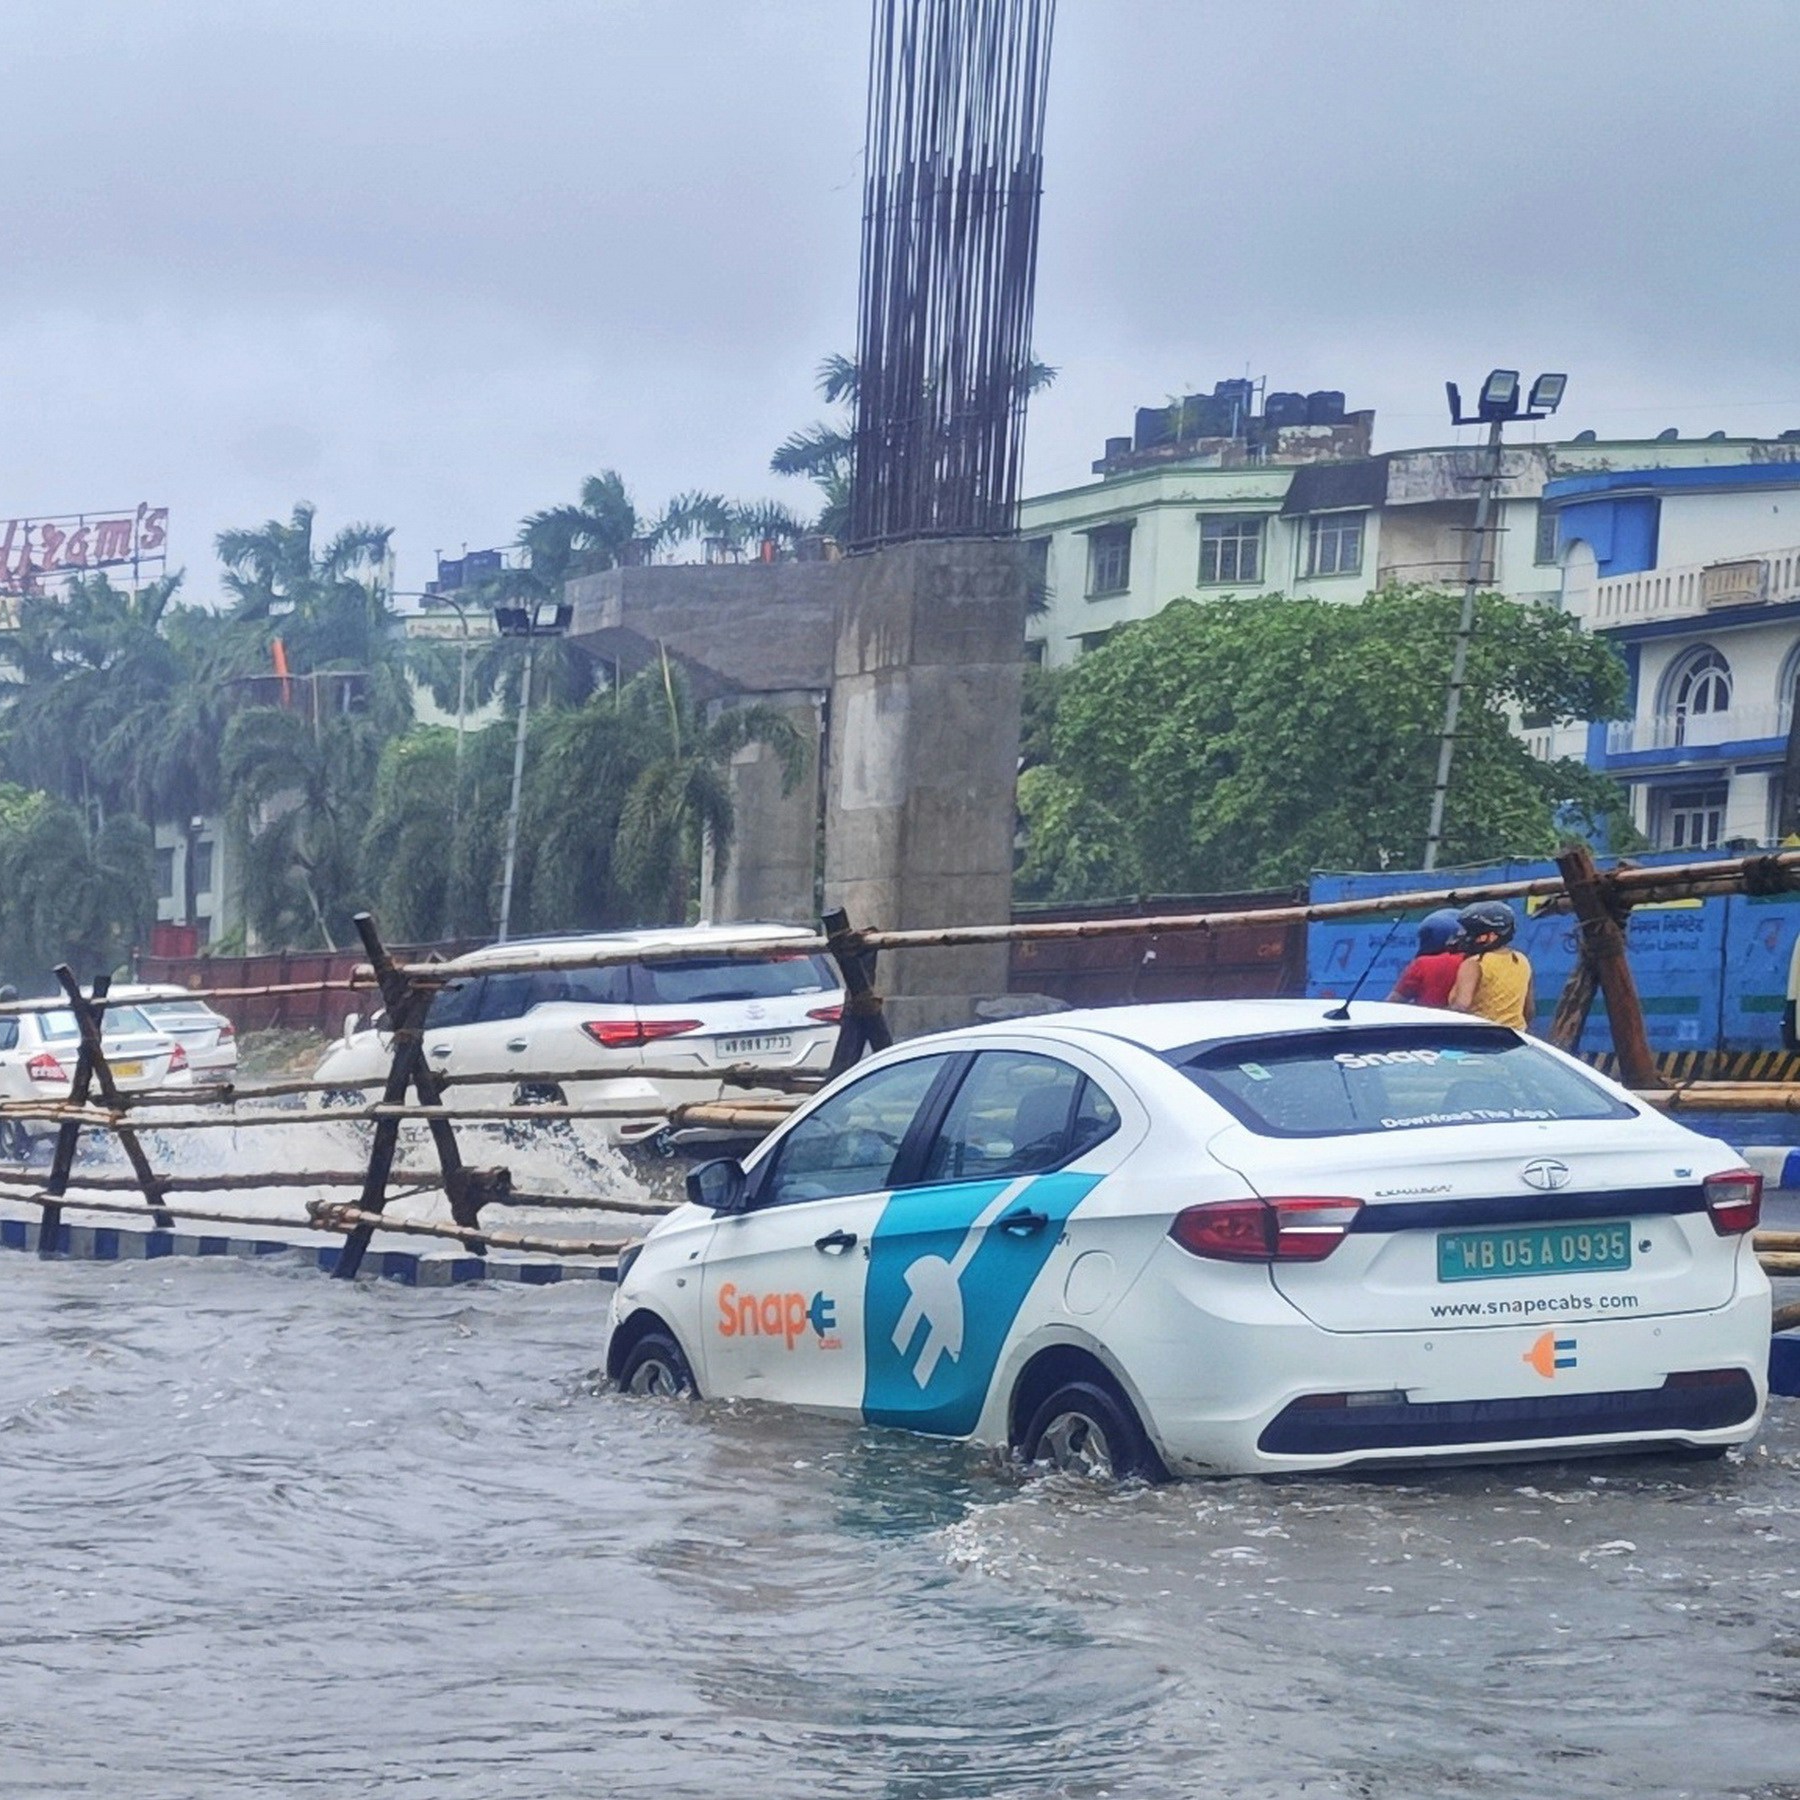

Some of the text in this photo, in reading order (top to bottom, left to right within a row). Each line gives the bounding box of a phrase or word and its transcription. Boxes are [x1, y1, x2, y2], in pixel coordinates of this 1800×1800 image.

[1381, 1110, 1471, 1129] Download
[1472, 1109, 1509, 1120] The
[1462, 1232, 1625, 1269] WB 05 A 0935
